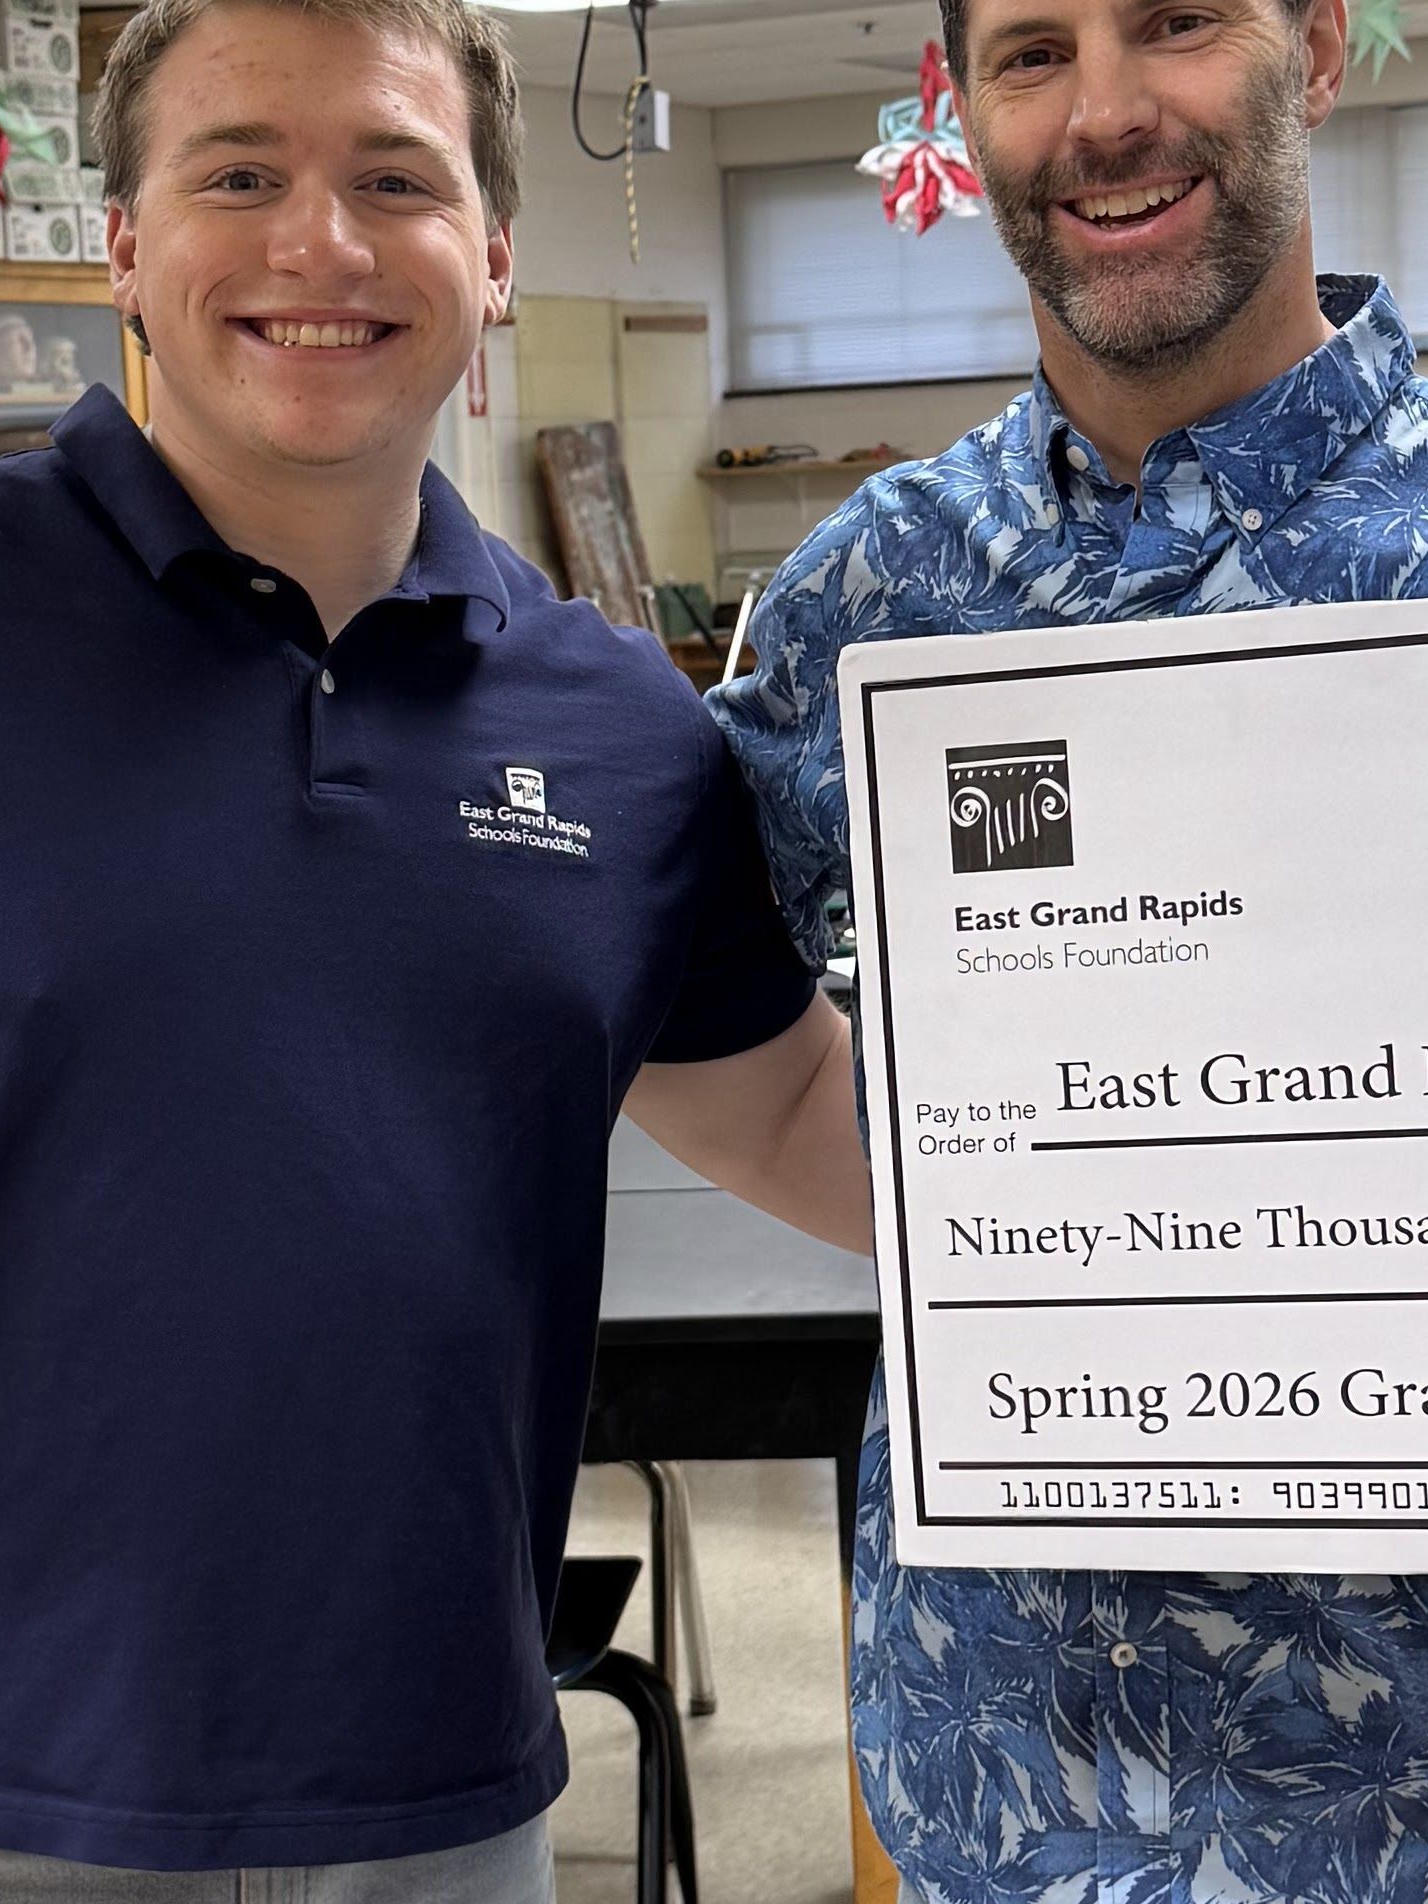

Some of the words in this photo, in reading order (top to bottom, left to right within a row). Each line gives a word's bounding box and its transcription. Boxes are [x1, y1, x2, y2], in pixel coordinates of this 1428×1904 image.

[459, 800, 494, 820] East
[497, 806, 545, 828] Grand
[547, 814, 592, 839] Rapids
[468, 822, 522, 844] Schools
[523, 828, 590, 858] Foundation
[954, 906, 1021, 932] East
[1030, 896, 1128, 927] Grand
[1139, 889, 1244, 927] Rapids
[956, 944, 1054, 974] Schools
[1064, 936, 1209, 968] Foundation
[1055, 1061, 1181, 1111] East
[1200, 1043, 1402, 1105] Grand
[916, 1103, 960, 1128] Pay
[967, 1102, 991, 1122] to
[998, 1100, 1037, 1121] the
[918, 1133, 986, 1156] Order
[993, 1131, 1016, 1153] of
[944, 1211, 1242, 1267] Ninety-Nine
[988, 1372, 1169, 1435] Spring
[1185, 1370, 1320, 1418] 2026
[1000, 1481, 1240, 1509] 1100137511:
